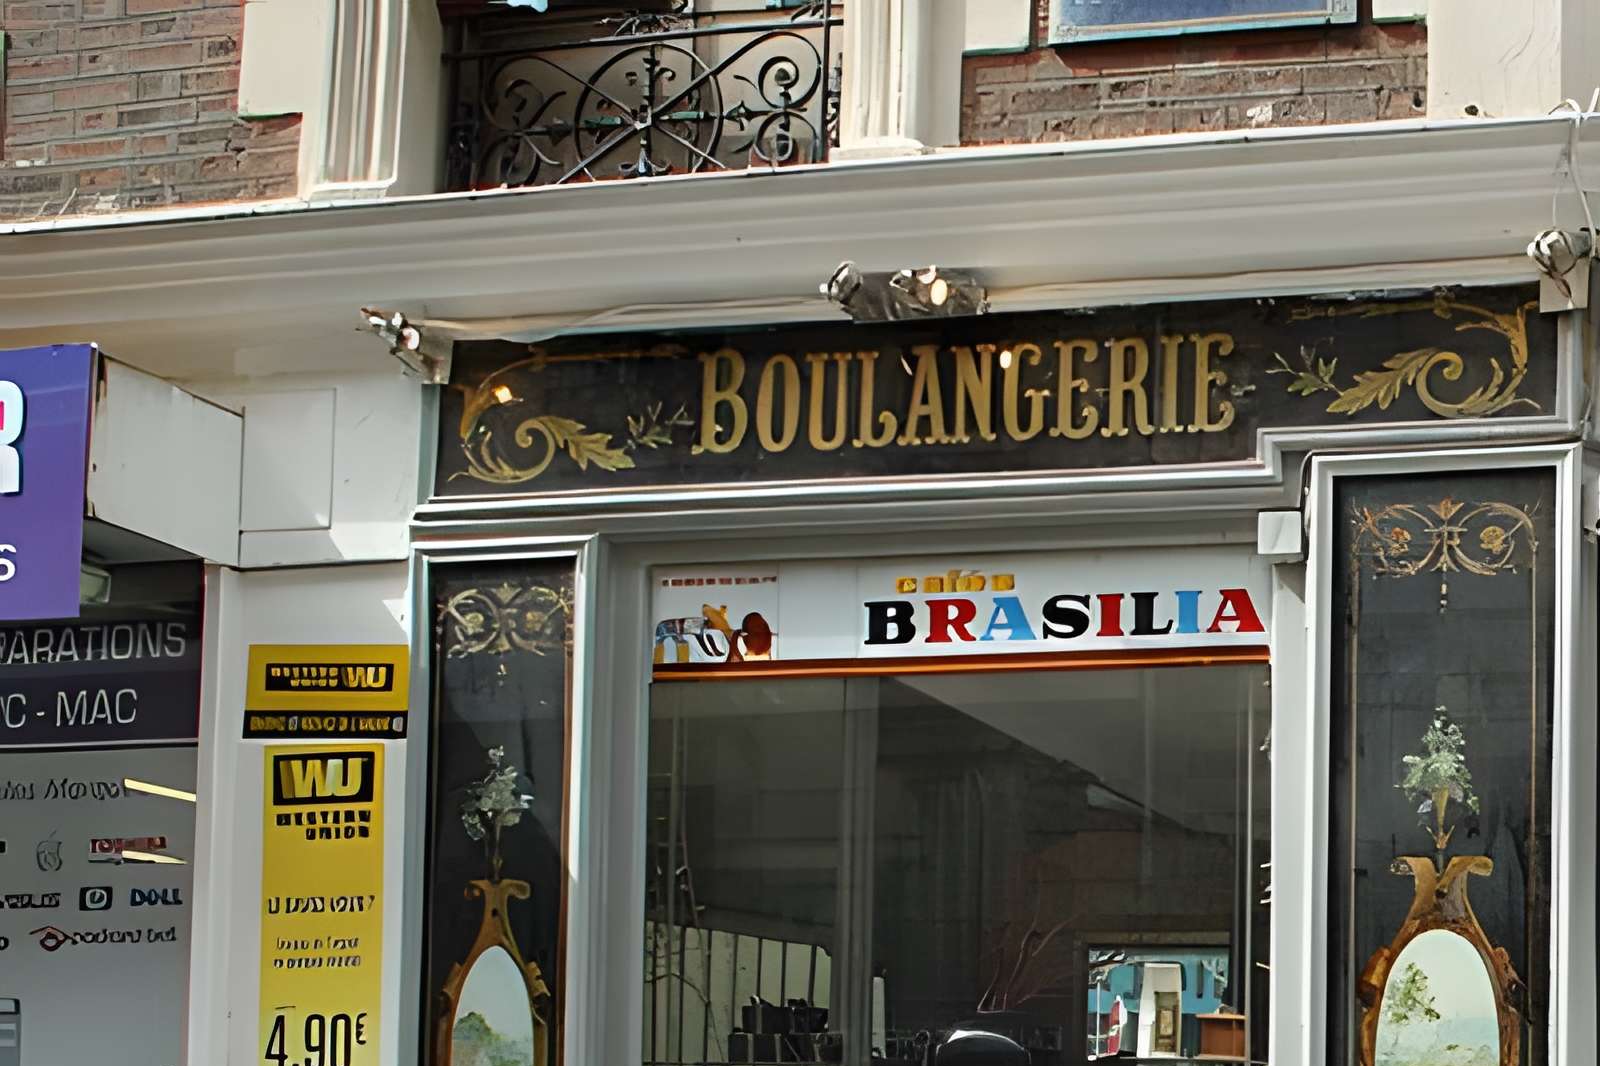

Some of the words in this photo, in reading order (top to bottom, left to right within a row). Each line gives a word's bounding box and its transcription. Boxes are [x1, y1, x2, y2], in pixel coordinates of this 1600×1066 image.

[691, 332, 1236, 455] BOULANGERIE
[863, 588, 1266, 645] BRASILIA
[0, 692, 26, 728] C
[56, 689, 137, 727] MAC
[280, 757, 368, 799] WU
